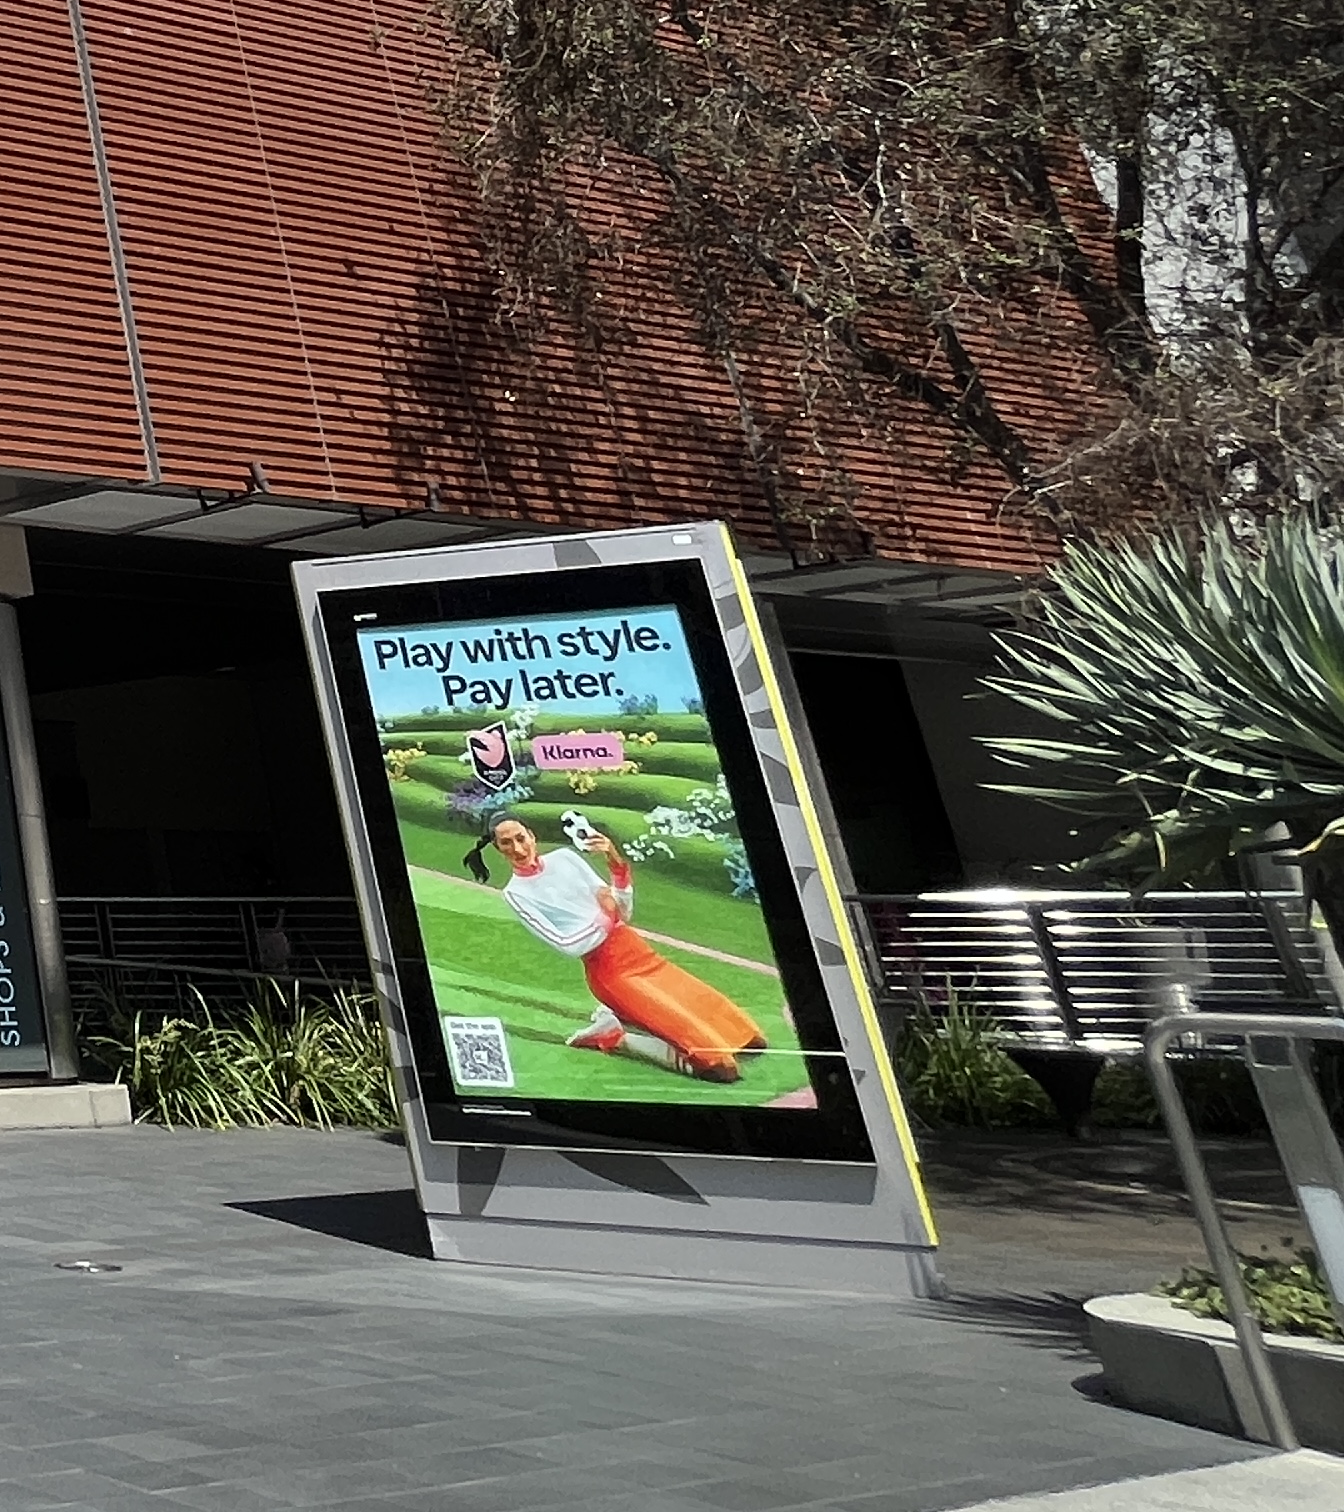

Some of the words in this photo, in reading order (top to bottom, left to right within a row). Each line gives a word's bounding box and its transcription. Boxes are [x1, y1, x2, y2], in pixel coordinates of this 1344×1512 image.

[374, 637, 454, 673] Play
[460, 627, 550, 665] with
[558, 619, 672, 663] style.
[442, 672, 514, 710] Pay
[519, 667, 624, 703] later.
